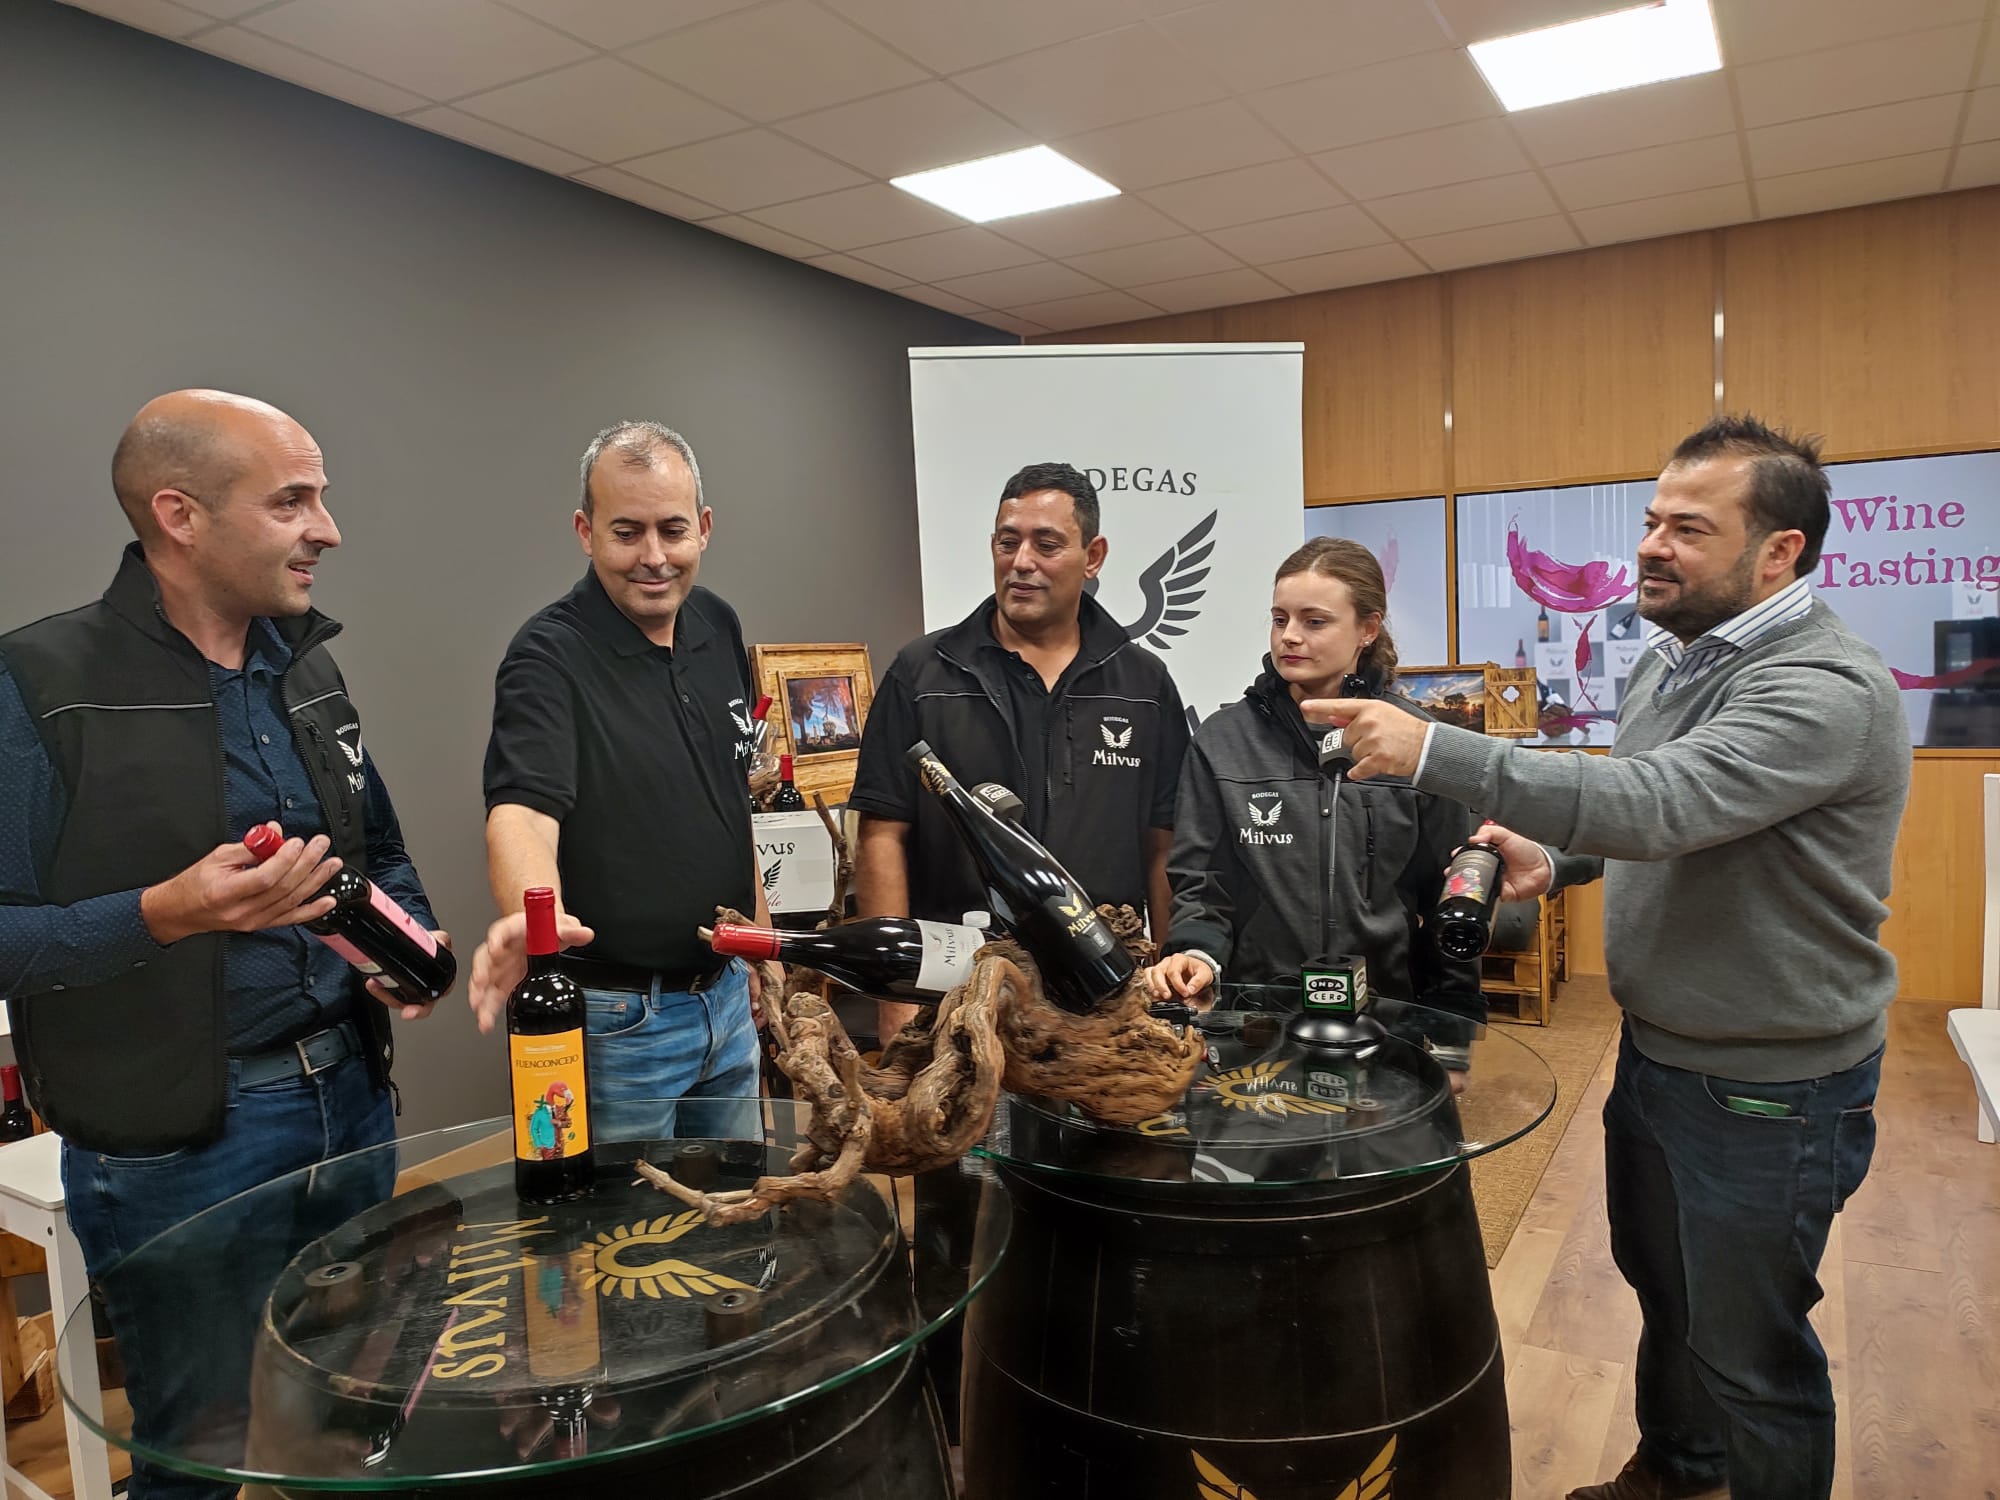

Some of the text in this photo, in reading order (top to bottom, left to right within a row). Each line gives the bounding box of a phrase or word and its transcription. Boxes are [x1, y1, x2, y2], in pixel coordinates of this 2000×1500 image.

[1083, 467, 1197, 496] DEGAS
[1831, 495, 1965, 533] Wine
[1817, 548, 2000, 592] Tasting
[1092, 749, 1141, 768] Milvus
[1239, 827, 1294, 845] Milvus
[756, 842, 795, 856] vus
[944, 927, 956, 967] Milvus
[1311, 980, 1342, 988] ONDA
[1314, 993, 1342, 1001] CERO
